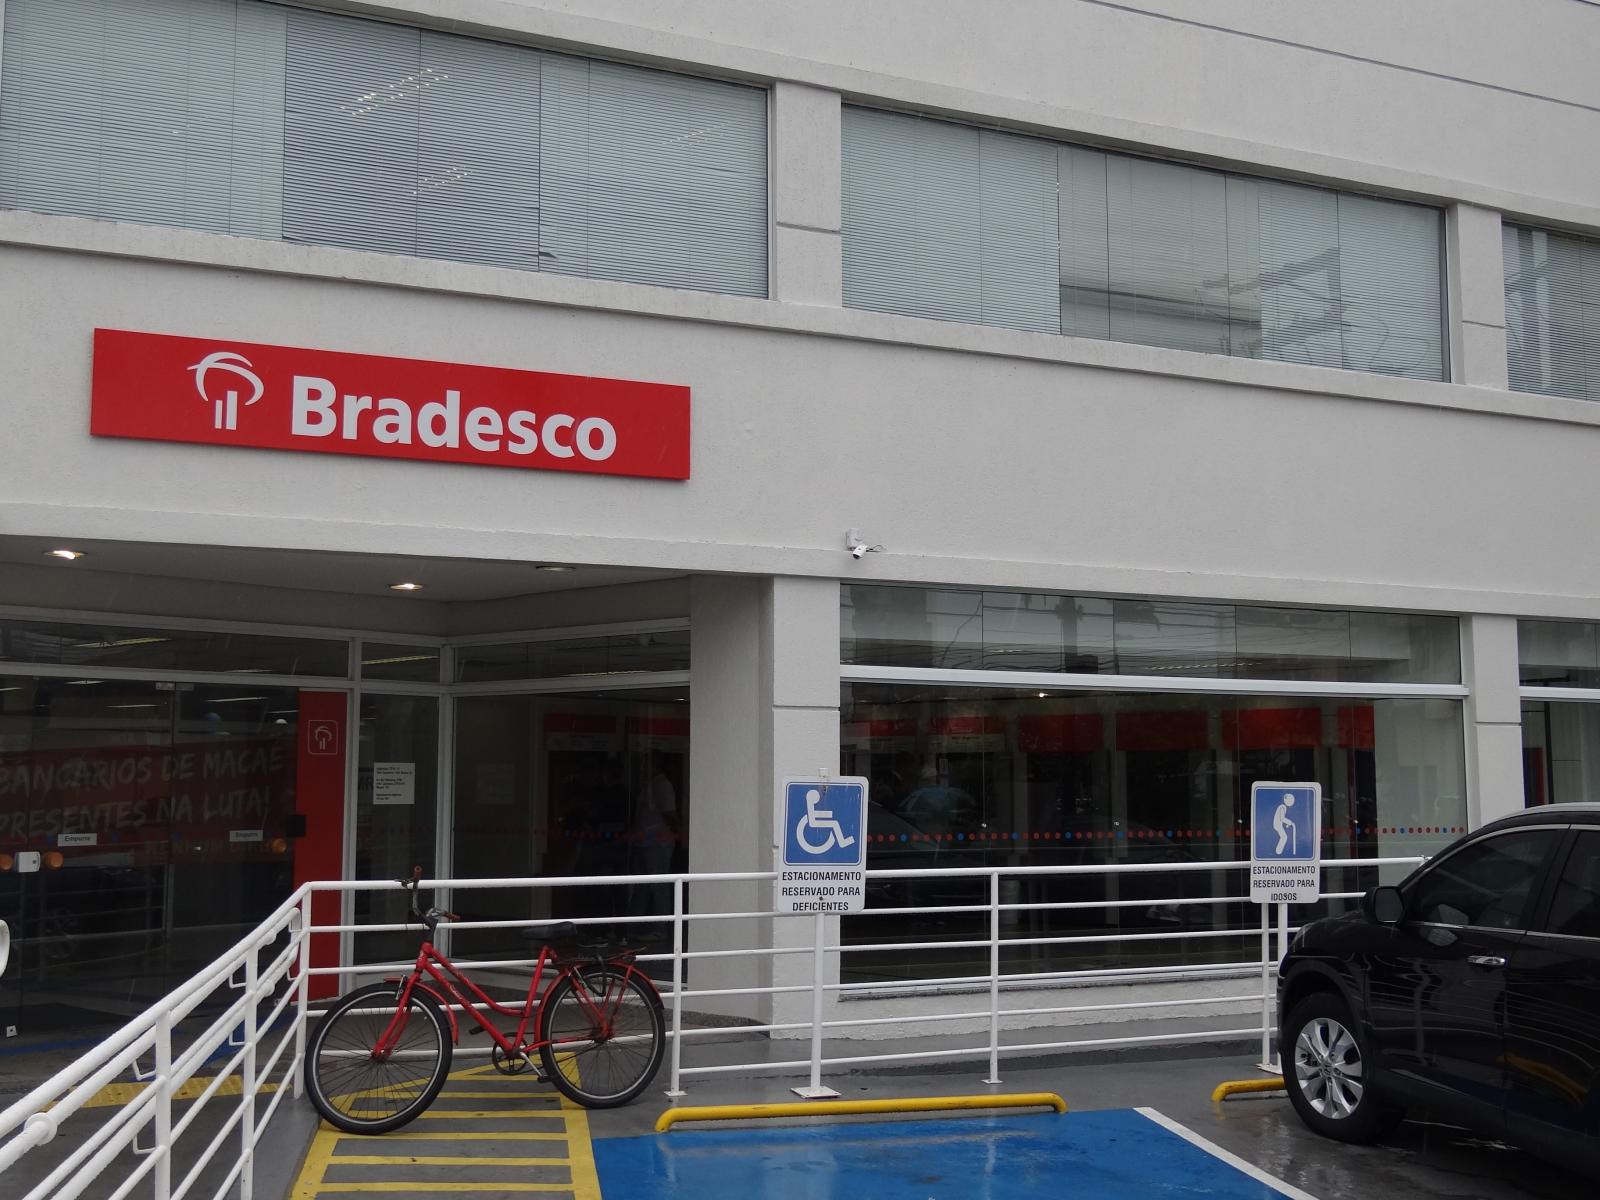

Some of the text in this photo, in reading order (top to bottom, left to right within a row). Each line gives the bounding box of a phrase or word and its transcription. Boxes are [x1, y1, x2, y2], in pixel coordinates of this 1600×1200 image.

[290, 375, 617, 462] Bradesco
[161, 752, 195, 781] DE
[156, 795, 193, 824] NA
[1253, 866, 1315, 874] ESTACIONAMENTO
[783, 872, 861, 880] ESTACIONAMENTO
[1253, 879, 1315, 888] RESERVADO PARA
[782, 886, 860, 896] RESERVADO PARA
[1271, 893, 1297, 901] IDOSOS
[792, 902, 849, 911] DEFICIENTES
